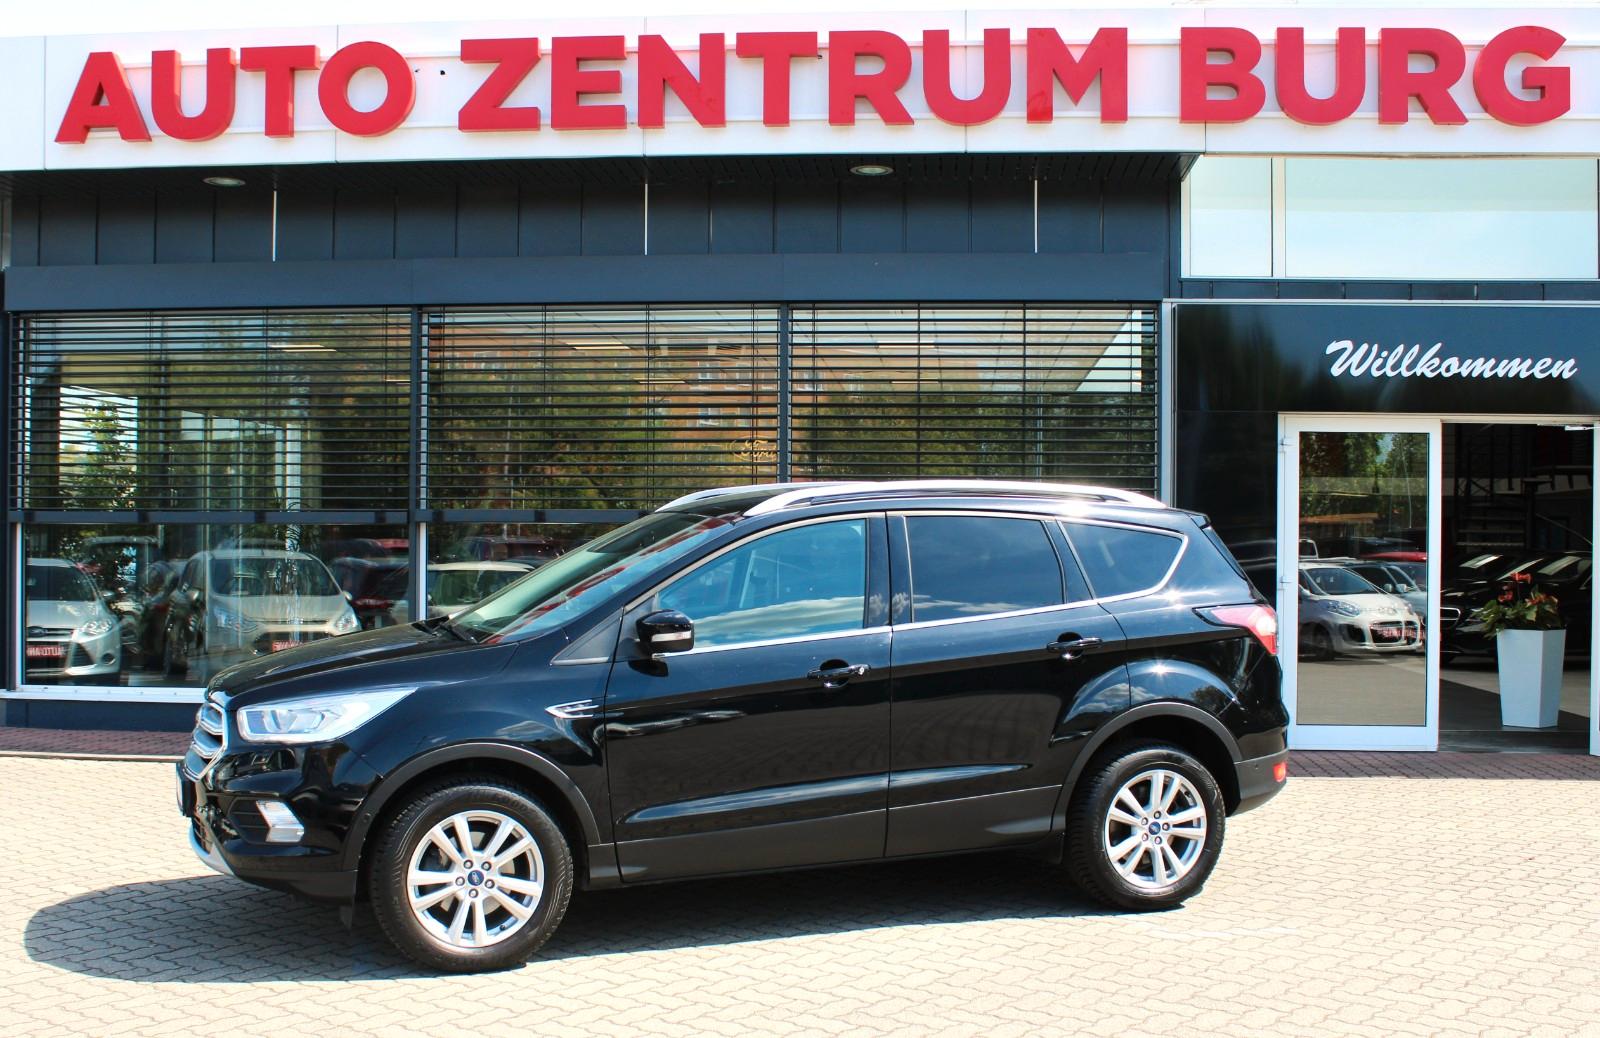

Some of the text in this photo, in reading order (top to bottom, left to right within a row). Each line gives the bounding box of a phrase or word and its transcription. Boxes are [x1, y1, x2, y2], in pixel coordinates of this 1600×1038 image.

[54, 25, 1571, 144] AUTO ZENTRUM BURG
[1325, 340, 1578, 379] Willkommen
